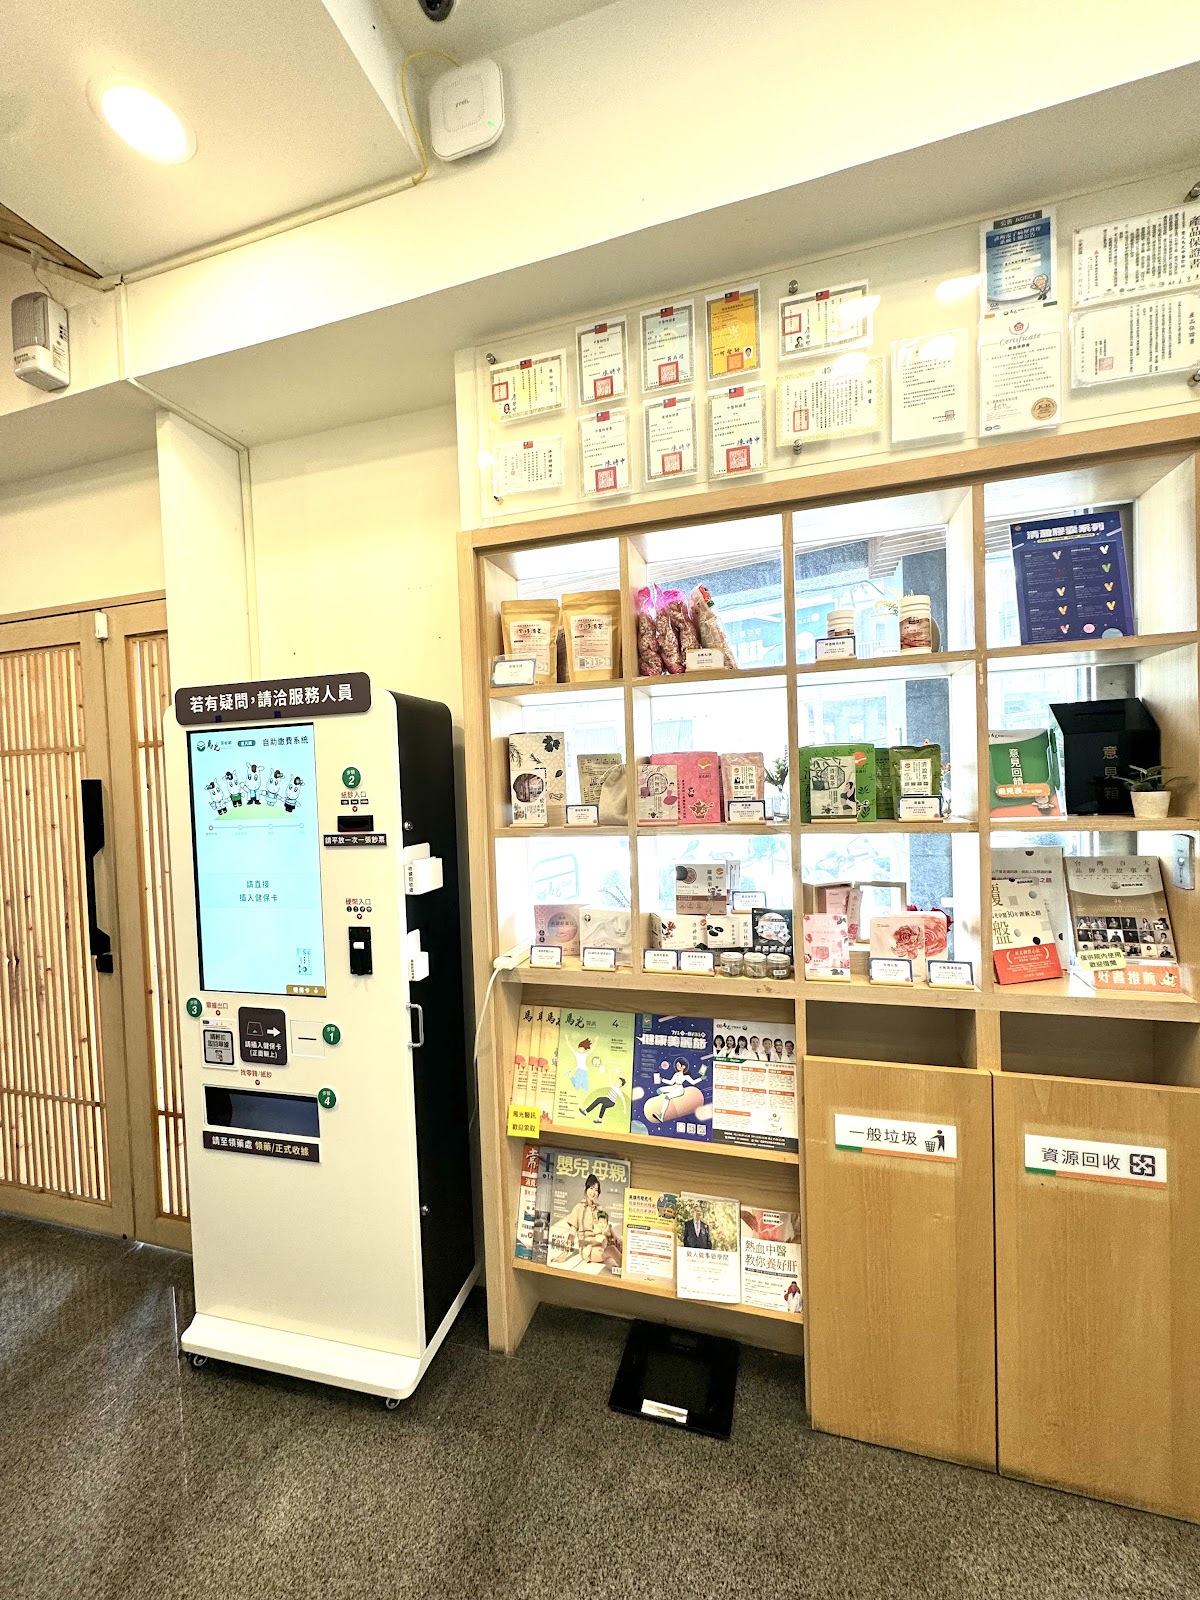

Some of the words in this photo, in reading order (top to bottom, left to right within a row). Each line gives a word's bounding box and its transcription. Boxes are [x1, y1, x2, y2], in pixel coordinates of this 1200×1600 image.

[1000, 333, 1041, 346] Certificate
[262, 735, 309, 747] 自助繳費系統
[1102, 745, 1118, 800] 意見箱
[348, 775, 356, 786] 2
[246, 880, 270, 889] 請直接
[239, 893, 278, 902] 插入健保卡
[191, 1005, 198, 1015] 3
[612, 1019, 619, 1028] 4
[329, 1032, 335, 1043] 1
[642, 1033, 707, 1050] 健康美麗節
[323, 1096, 331, 1106] 4
[849, 1127, 918, 1147] 一般垃圾
[1040, 1147, 1121, 1171] 資源回收
[744, 1239, 787, 1257] 熱血中醫
[744, 1253, 798, 1273] 教你養好肝
